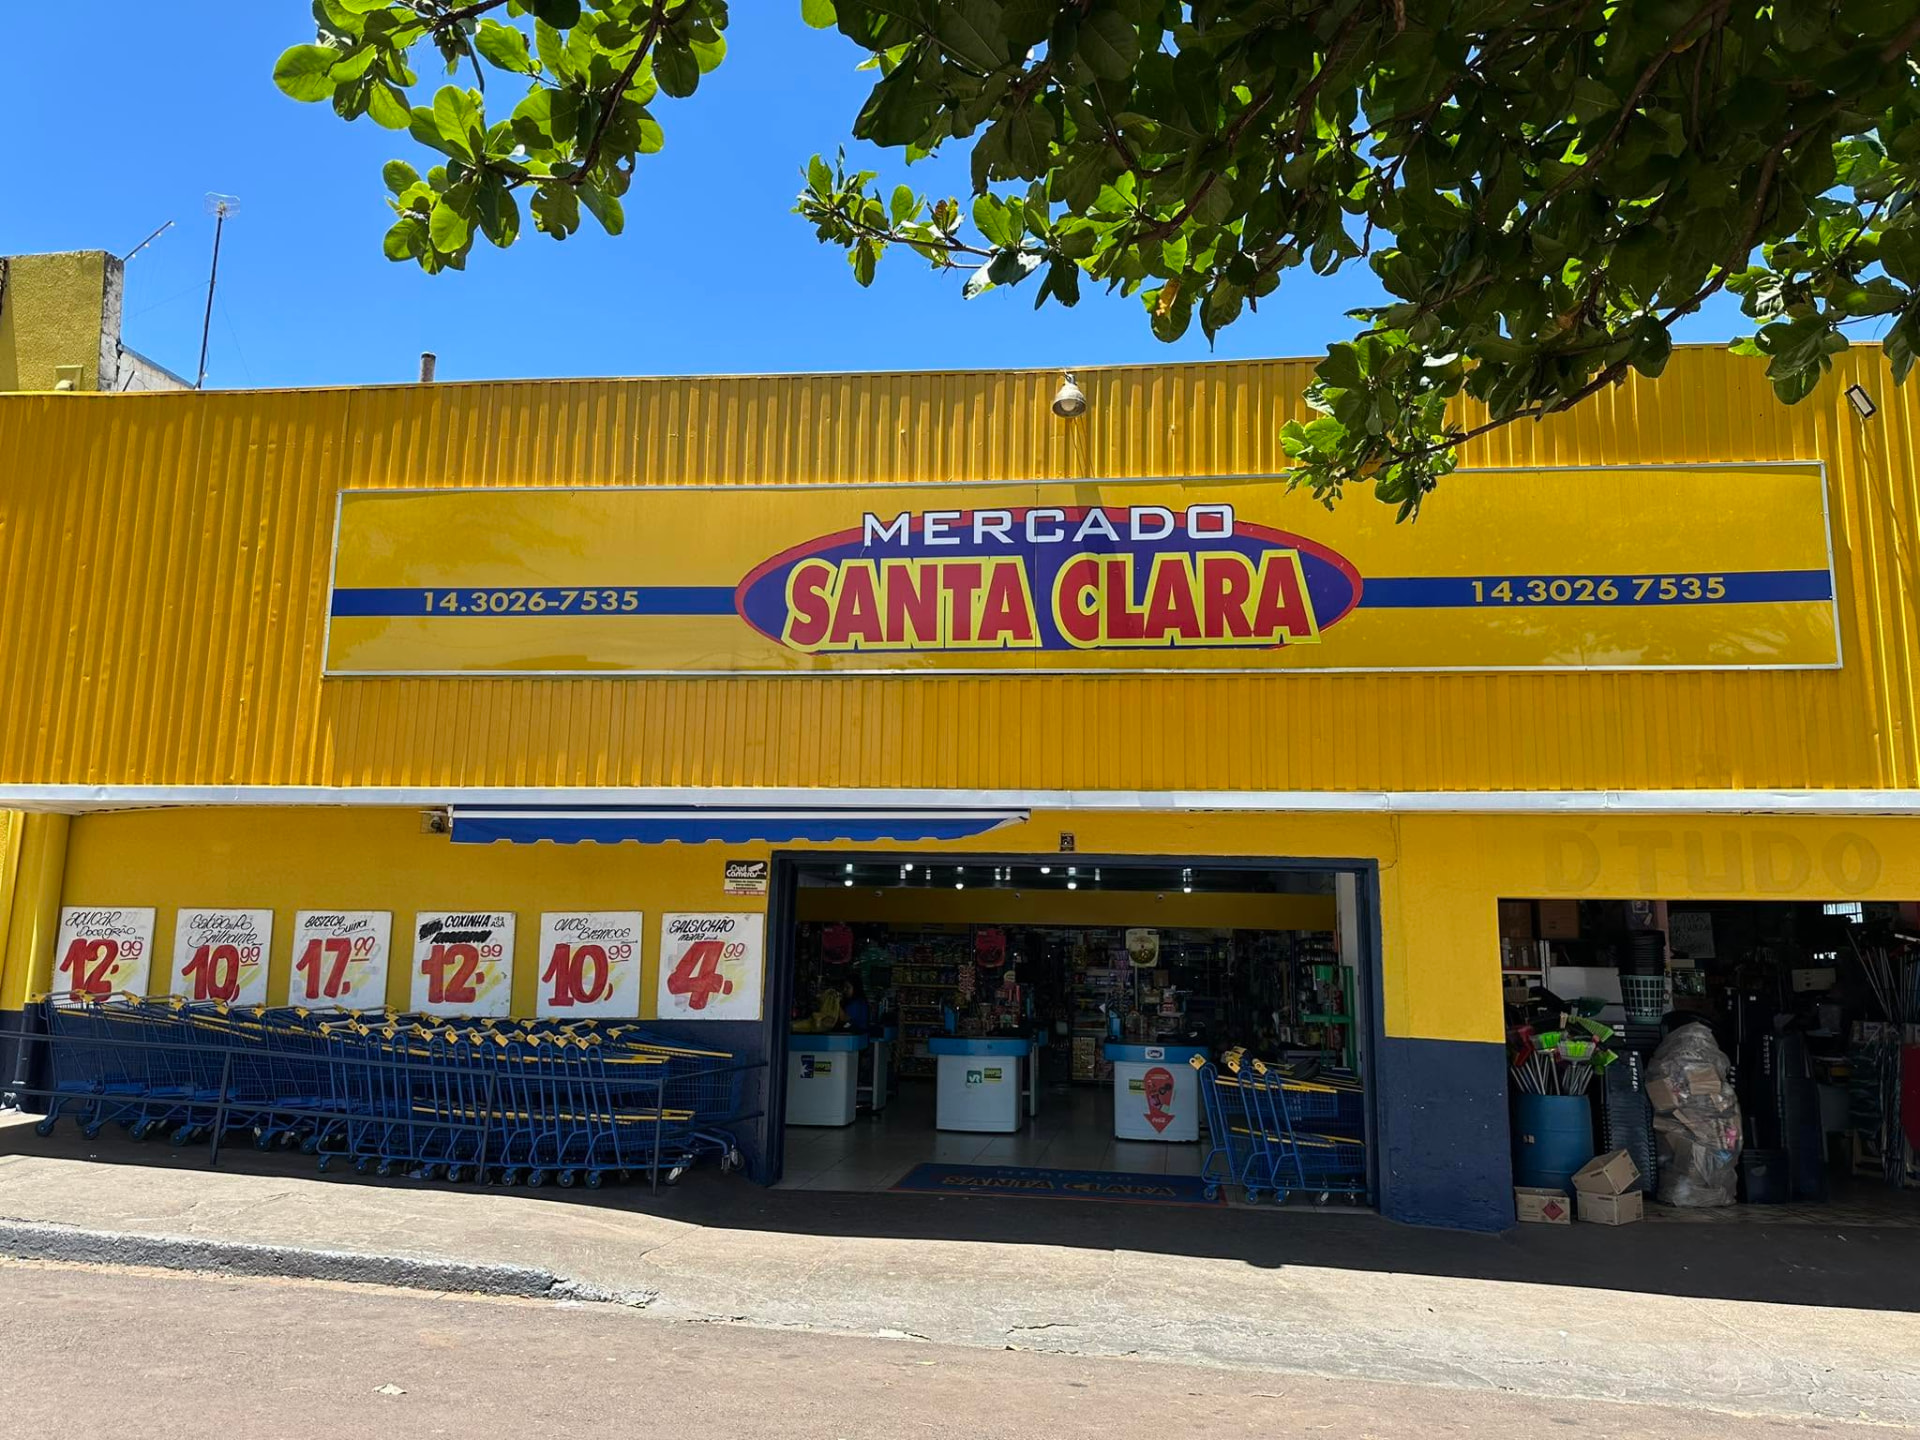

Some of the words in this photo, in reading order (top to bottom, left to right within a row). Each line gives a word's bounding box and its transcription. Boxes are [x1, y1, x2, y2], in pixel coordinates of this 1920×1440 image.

[863, 503, 1235, 547] MERCADO
[781, 555, 1043, 653] SANTA
[1051, 549, 1321, 650] CLARA
[1471, 579, 1620, 603] 14.3026
[1632, 576, 1727, 601] 7535
[423, 590, 639, 613] 14.3026-7535
[1617, 830, 1882, 895] TUDO
[444, 914, 492, 928] COXINHA
[669, 915, 736, 934] SALSICHÃO
[480, 943, 503, 958] 99
[608, 944, 632, 961] 99
